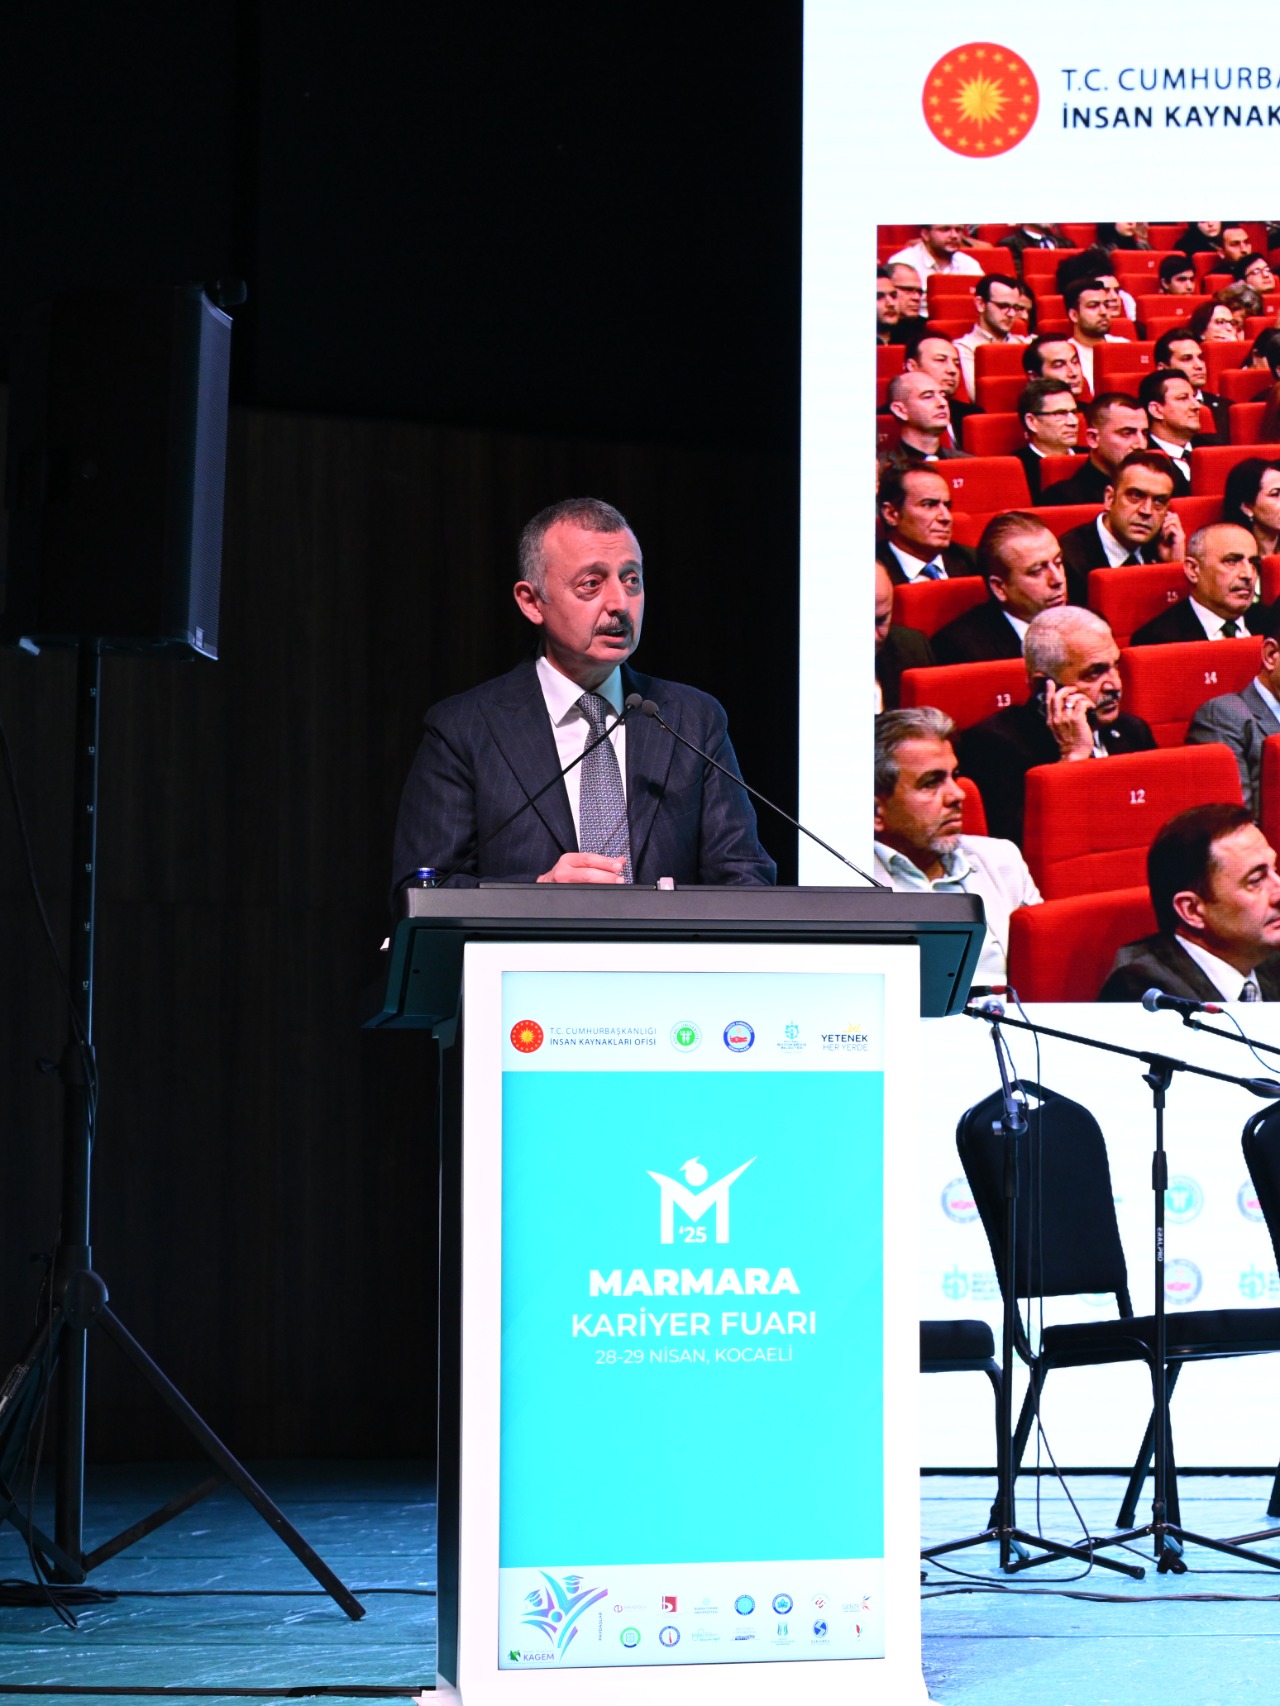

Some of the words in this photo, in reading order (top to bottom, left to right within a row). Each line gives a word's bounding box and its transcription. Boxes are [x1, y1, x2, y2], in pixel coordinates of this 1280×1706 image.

[1061, 68, 1108, 92] T.C.
[1062, 102, 1153, 129] İNSAN
[1204, 671, 1217, 684] 14
[996, 693, 1011, 707] 13
[1130, 789, 1146, 804] 12
[565, 1026, 657, 1036] CUMHURBAŞKANLIĞI
[550, 1037, 576, 1046] İNSAN
[579, 1038, 632, 1046] KAYNAKLARI
[634, 1037, 657, 1046] OFİSİ
[821, 1034, 868, 1043] YETENEK
[822, 1043, 840, 1052] HER
[841, 1043, 868, 1052] YERDE
[588, 1267, 801, 1297] MARMARA
[572, 1306, 711, 1338] KARİYER
[721, 1310, 817, 1336] FUARI
[595, 1349, 645, 1365] 28-29
[649, 1347, 710, 1366] NİSAN,
[714, 1344, 794, 1363] KOCAELİ
[523, 1653, 555, 1662] KAGEM
